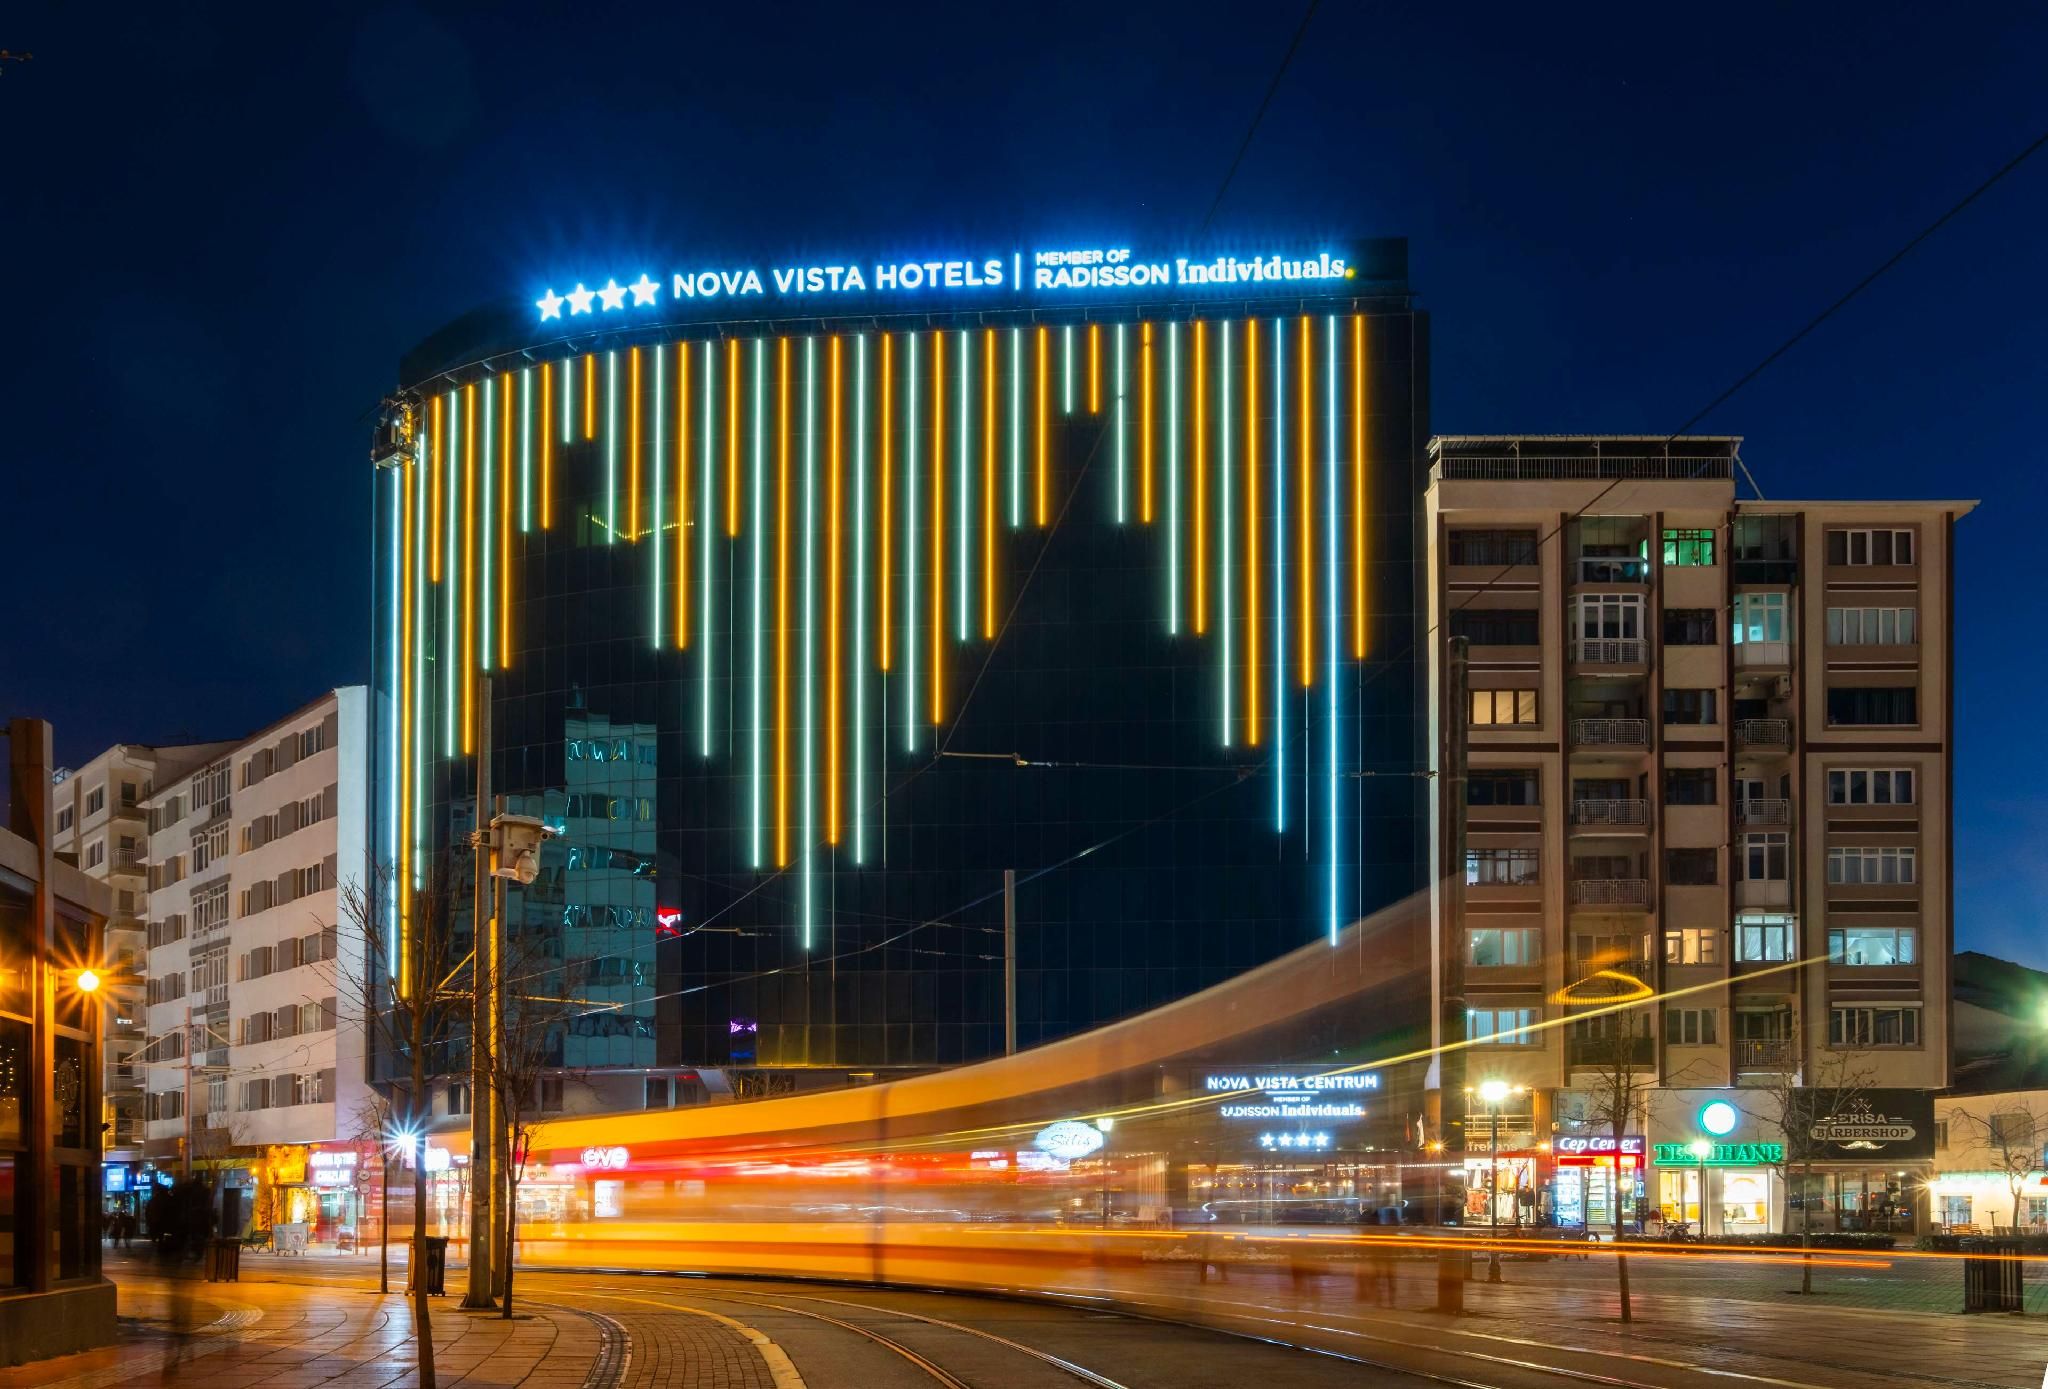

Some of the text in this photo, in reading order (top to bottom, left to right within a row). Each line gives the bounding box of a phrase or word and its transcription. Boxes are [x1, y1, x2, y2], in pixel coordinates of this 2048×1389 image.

[1035, 249, 1130, 266] MEMBER OF
[673, 260, 1003, 299] NOVA VISTA HOTELS
[1035, 264, 1169, 289] RADISSON
[1207, 1075, 1377, 1090] NOVA VISTA CENTRUM
[1221, 1106, 1280, 1117] RADISSON
[1817, 1128, 1908, 1138] BARBERSHOP
[1559, 1137, 1637, 1154] Cep Cener
[1654, 1140, 1783, 1163] TESİHANE
